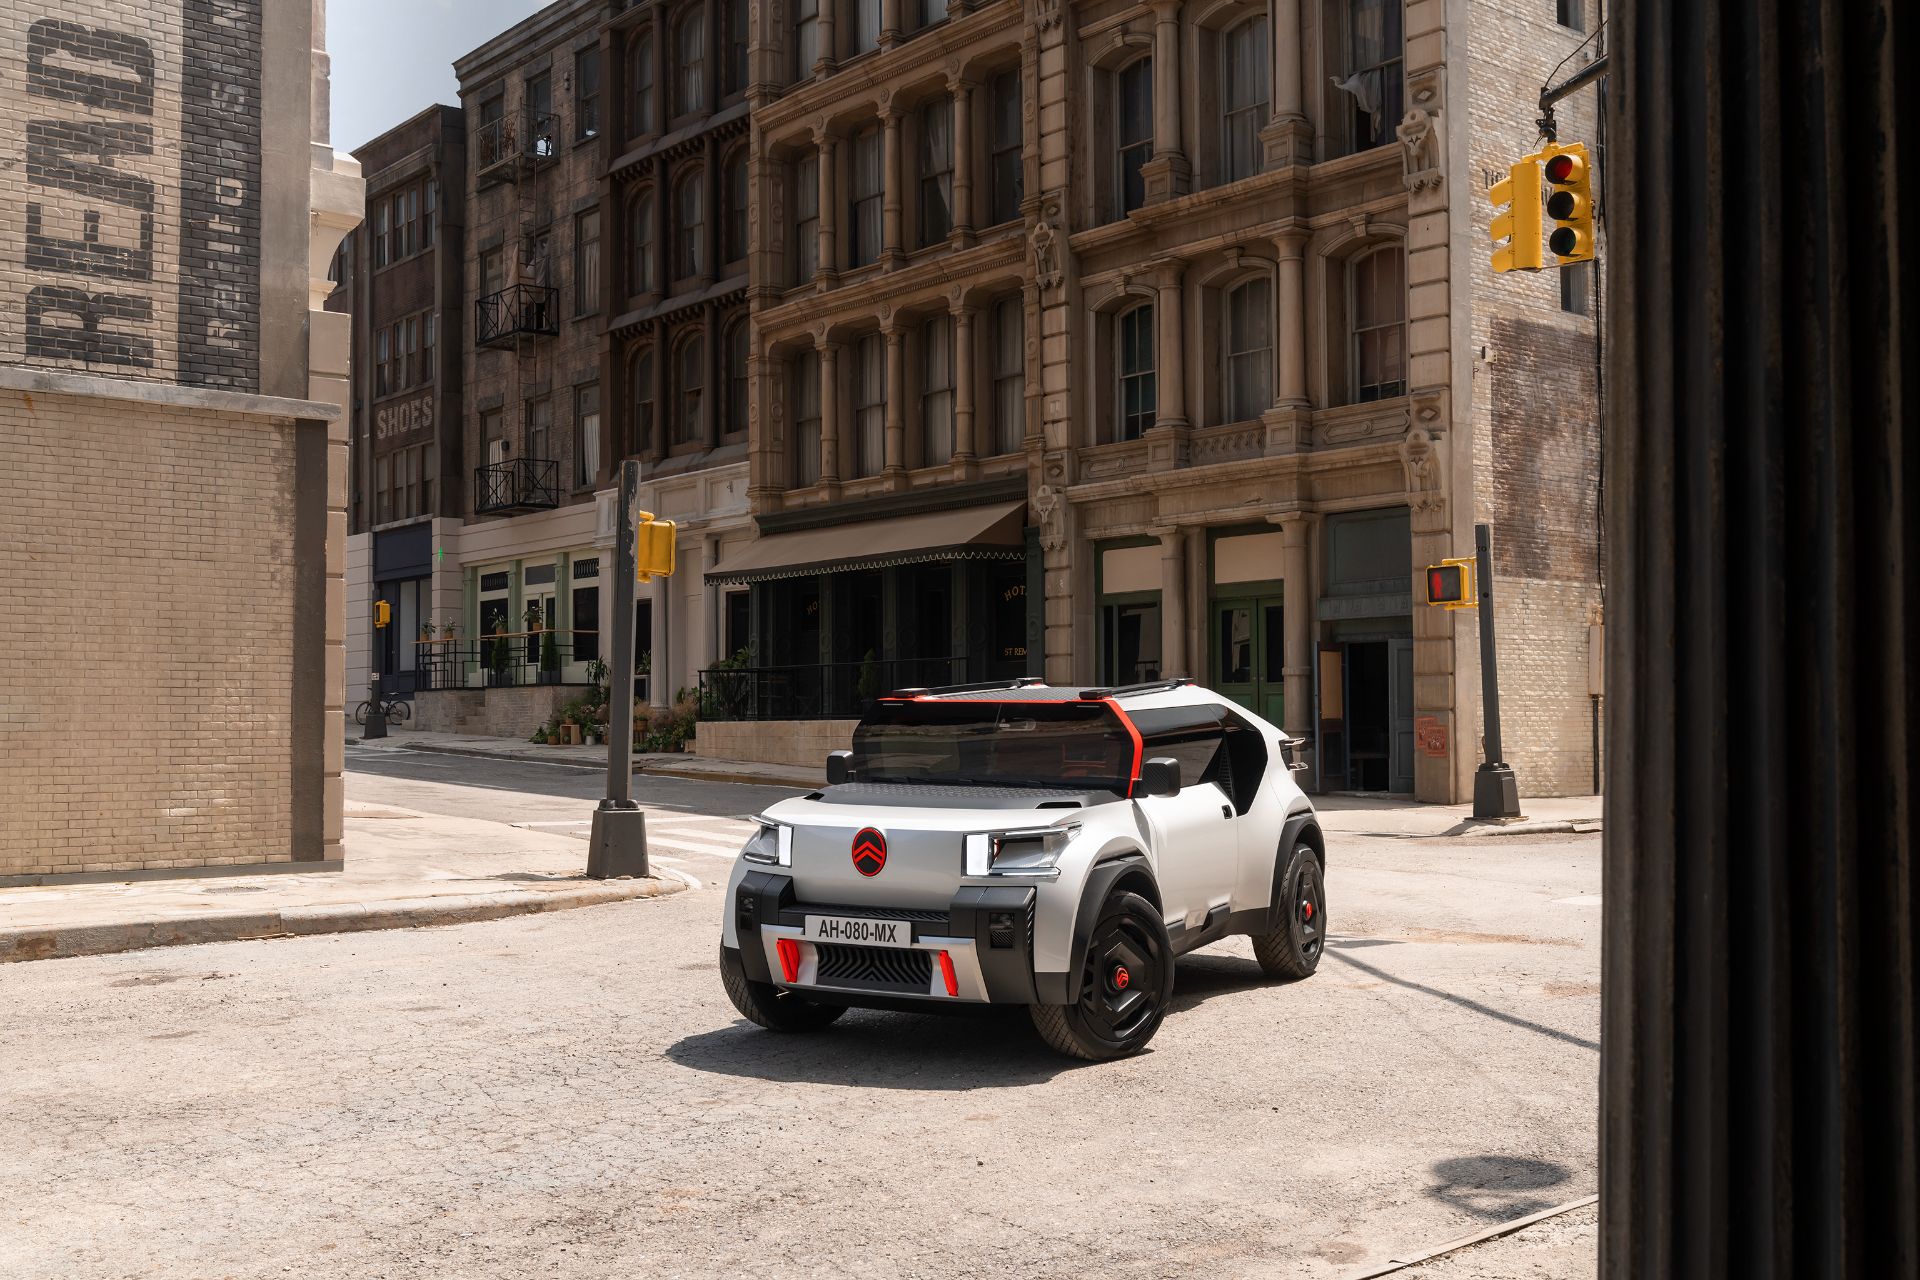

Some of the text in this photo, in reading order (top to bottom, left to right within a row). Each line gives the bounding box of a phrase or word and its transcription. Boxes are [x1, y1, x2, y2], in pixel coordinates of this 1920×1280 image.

[26, 18, 155, 368] READ
[376, 396, 433, 440] SHOES
[818, 919, 897, 943] AH-080-MX
